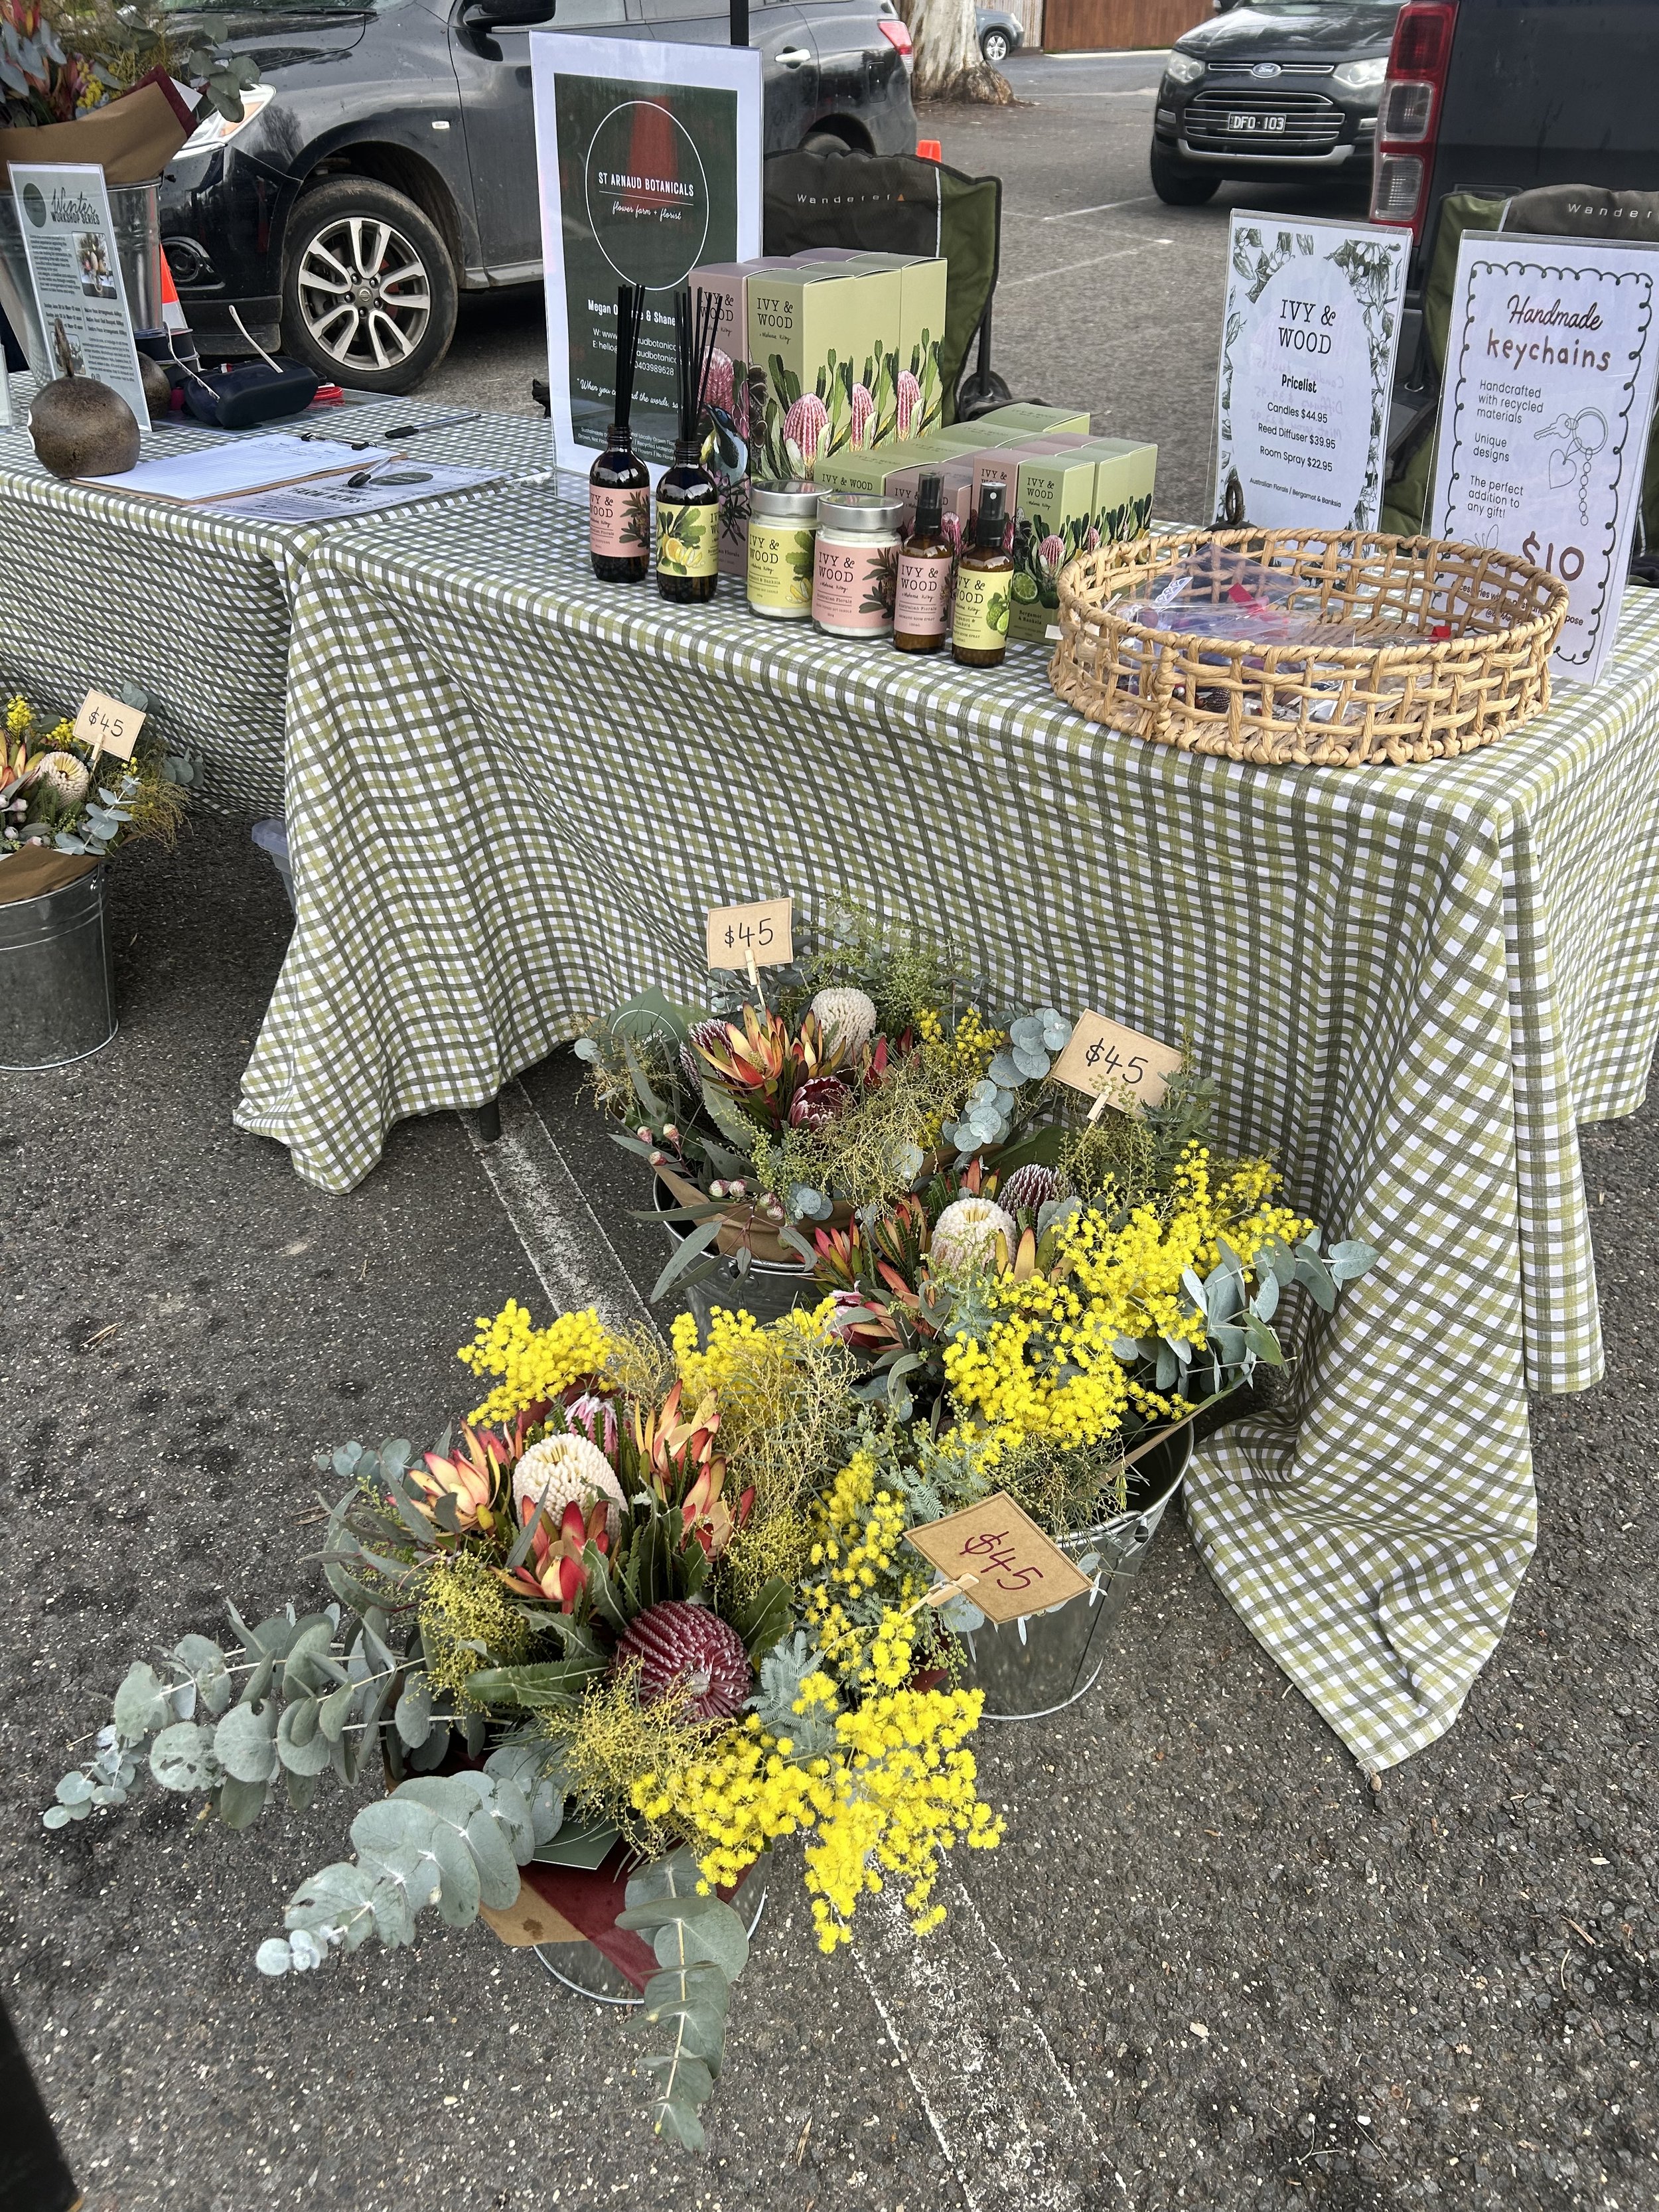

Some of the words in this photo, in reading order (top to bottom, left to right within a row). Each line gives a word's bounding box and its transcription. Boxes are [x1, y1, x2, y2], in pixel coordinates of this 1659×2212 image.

[1263, 117, 1284, 130] 103
[599, 171, 607, 184] ST
[611, 174, 642, 189] ARNAUD
[645, 178, 694, 197] BOTANICALS
[51, 186, 96, 214] Winter
[797, 193, 891, 204] Wanderer
[50, 211, 80, 223] WORKSHOP
[82, 213, 100, 225] SERIES
[612, 200, 634, 215] flower
[635, 204, 652, 218] farm
[659, 208, 682, 222] florist
[725, 293, 734, 307] &
[757, 297, 780, 311] IVY
[784, 301, 794, 314] &
[587, 299, 611, 316] Megan
[646, 310, 652, 322] &
[654, 311, 676, 327] Shane
[757, 313, 793, 329] WOOD
[1280, 299, 1316, 323] IVY
[1321, 305, 1336, 327] &
[1507, 294, 1603, 331] Handmade
[1278, 327, 1332, 354] WOOD
[1486, 328, 1611, 371] keychains
[1281, 374, 1317, 394] Pricelist
[1480, 380, 1542, 398] Handcrafted
[599, 386, 611, 396] you
[639, 392, 649, 403] the
[1479, 394, 1498, 406] with
[1500, 398, 1544, 413] recycled
[1267, 402, 1299, 417] Candles
[1301, 409, 1328, 424] $44.95
[1477, 408, 1522, 424] materials
[1258, 423, 1277, 435] Reed
[1279, 427, 1308, 443] Diffuser
[1309, 435, 1336, 449] $39.95
[1475, 432, 1507, 449] Unique
[1260, 445, 1282, 459] Room
[1283, 451, 1305, 468] Spray
[1307, 457, 1333, 472] $22.95
[1473, 446, 1510, 463] designs
[822, 473, 838, 484] IVY
[840, 477, 847, 486] &
[849, 479, 873, 491] WOOD
[981, 469, 998, 479] IVY
[1000, 471, 1007, 480] &
[1027, 477, 1045, 488] IVY
[1047, 480, 1054, 490] &
[895, 487, 912, 498] IVY
[1027, 488, 1054, 500] WOOD
[1250, 477, 1273, 488] Australian
[1273, 482, 1289, 493] Florals
[1292, 488, 1317, 502] Bergamot
[1321, 497, 1342, 508] Banksia
[1471, 475, 1486, 488] The
[1488, 480, 1524, 496] perfect
[604, 496, 614, 507] &
[1469, 489, 1508, 506] addition
[1510, 497, 1520, 508] to
[1467, 502, 1484, 516] any
[1486, 506, 1506, 519] gift!
[749, 534, 765, 548] IVY
[769, 539, 780, 551] &
[749, 548, 778, 564] WOOD
[819, 552, 839, 567] IVY
[843, 557, 855, 569] &
[1522, 531, 1585, 581] $10
[819, 565, 853, 583] WOOD
[901, 564, 924, 578] IVY
[928, 567, 938, 578] &
[901, 577, 937, 591] WOOD
[974, 579, 985, 591] &
[88, 706, 124, 737] $45
[724, 918, 774, 948] $45
[1085, 1037, 1149, 1084] $45
[960, 1530, 1044, 1590] $45
